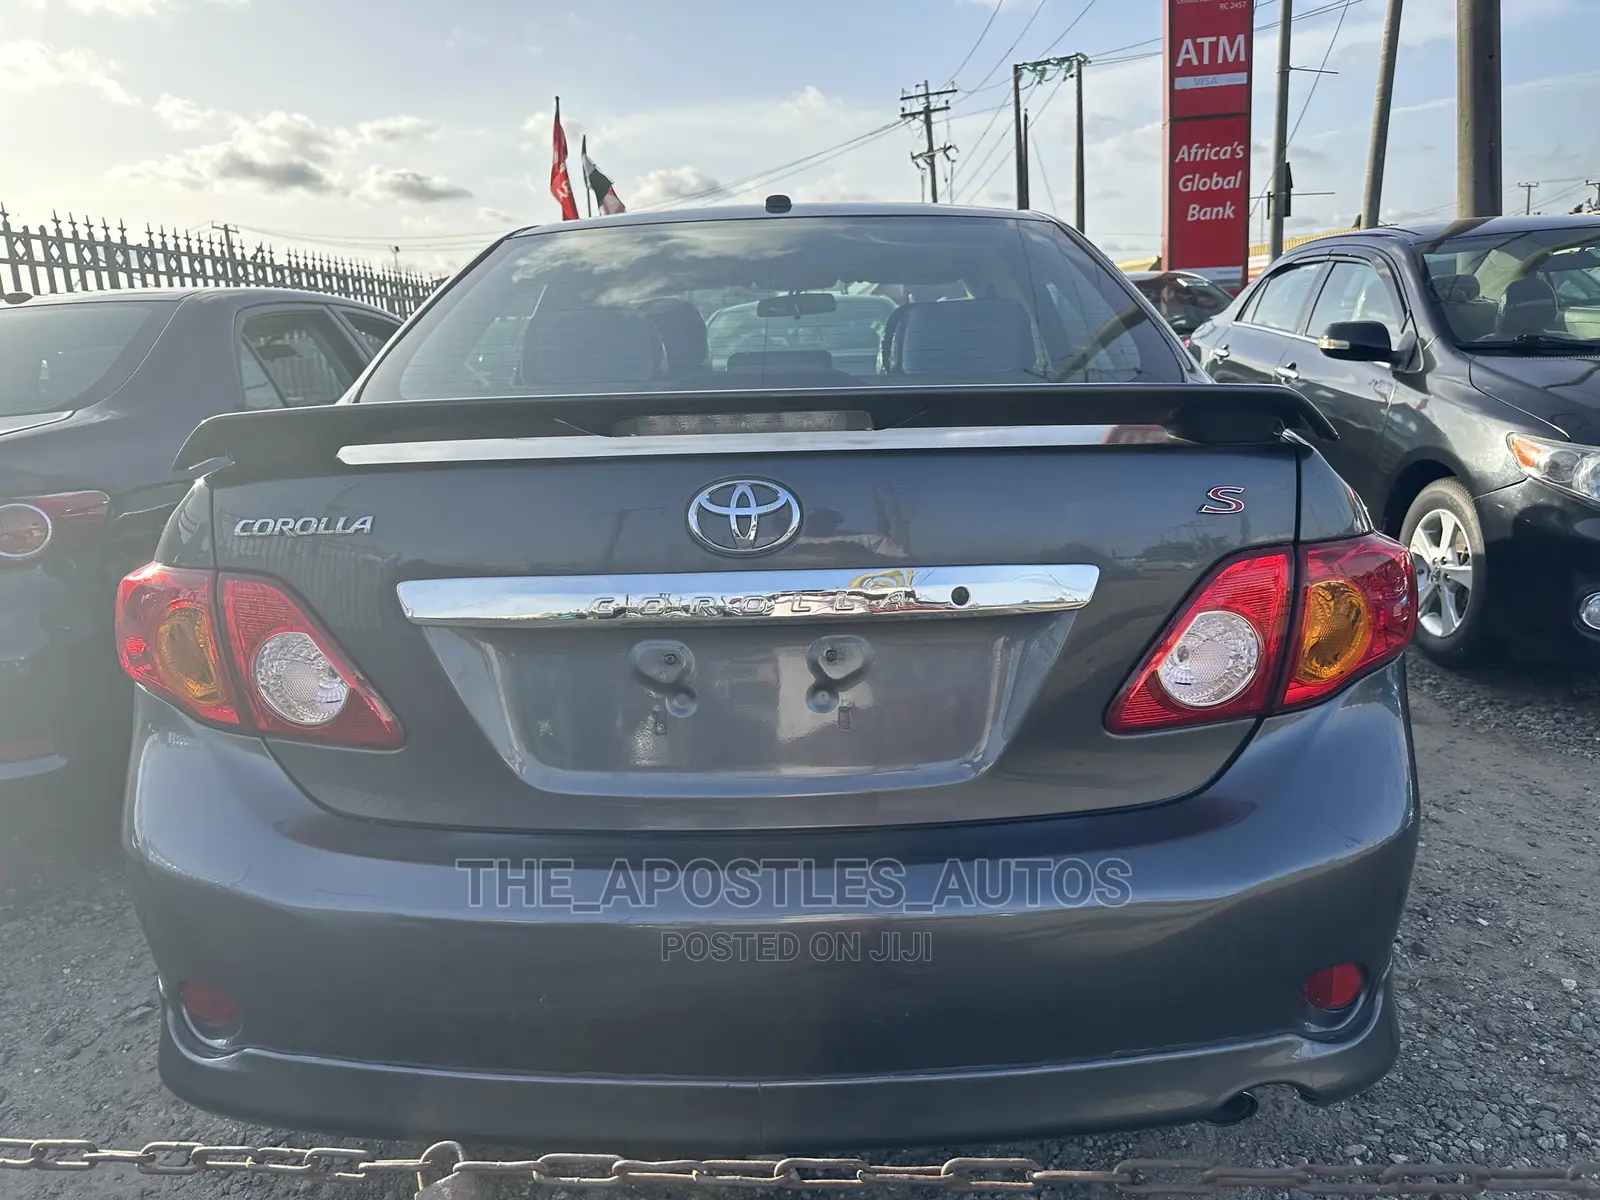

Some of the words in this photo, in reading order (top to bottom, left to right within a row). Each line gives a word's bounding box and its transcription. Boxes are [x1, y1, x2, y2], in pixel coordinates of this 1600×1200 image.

[1230, 1, 1247, 9] 2457
[1175, 33, 1246, 67] ATM
[1194, 77, 1218, 87] VISA
[1175, 140, 1245, 163] Africa's
[1178, 170, 1243, 192] Global
[1187, 201, 1236, 222] Bank
[1198, 485, 1245, 514] S
[233, 515, 375, 537] COROLLA
[586, 590, 912, 616] COROLLA
